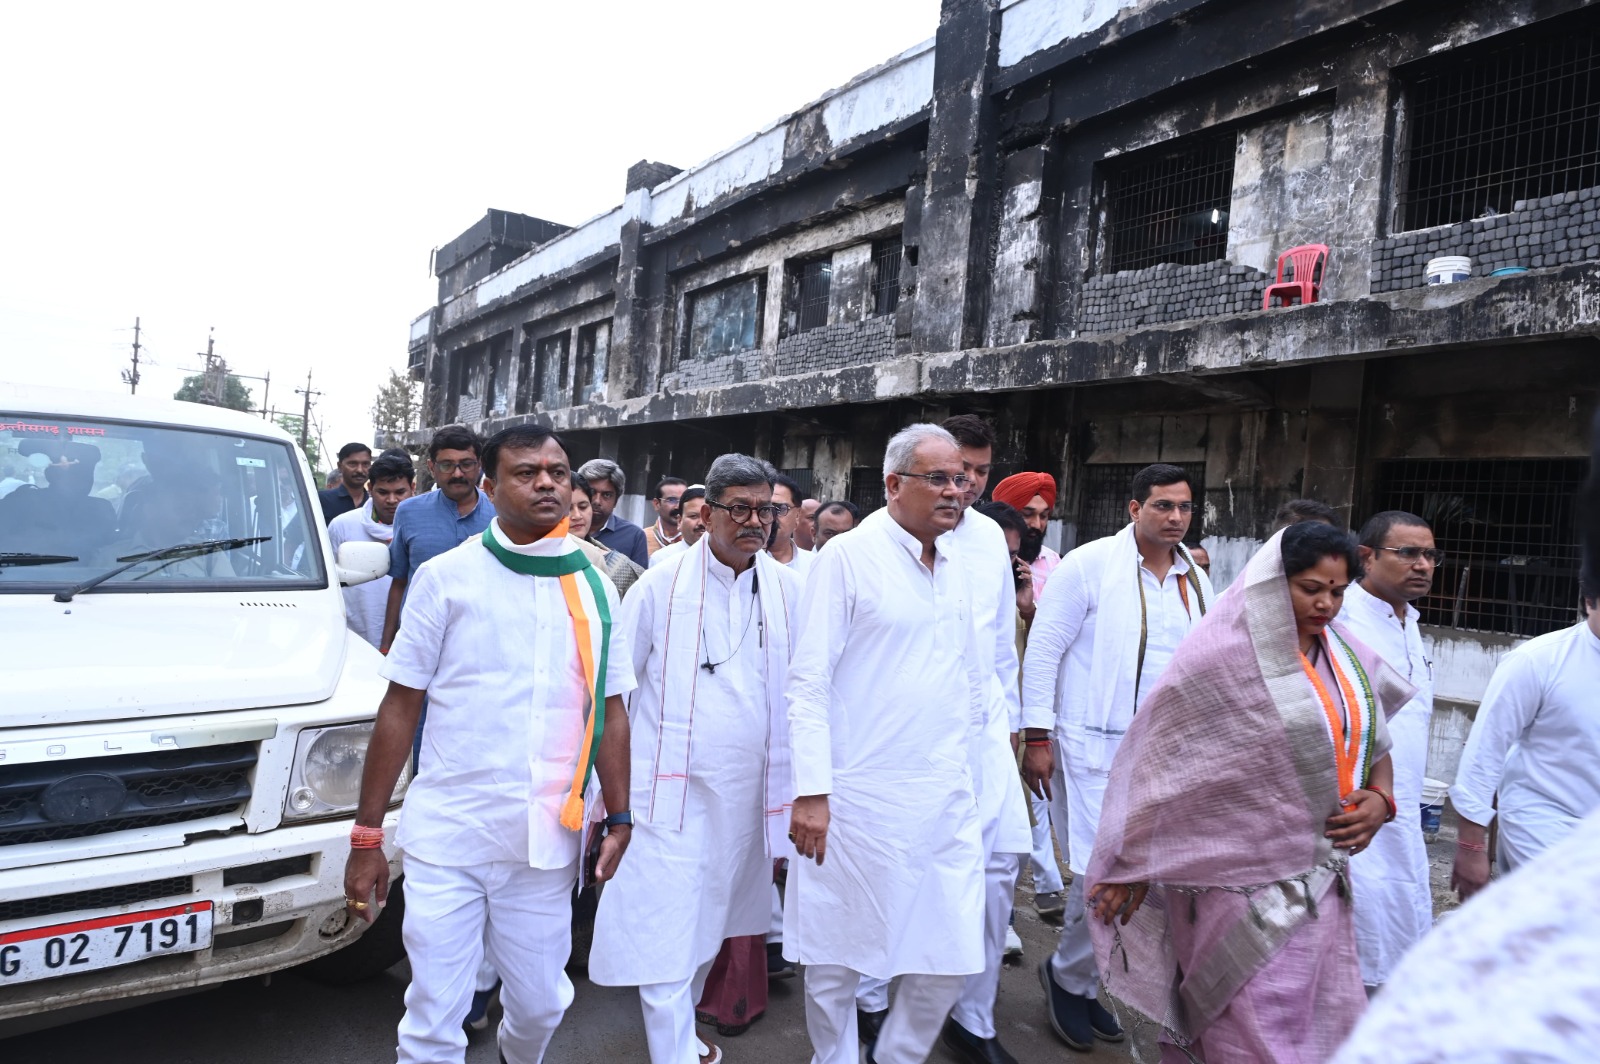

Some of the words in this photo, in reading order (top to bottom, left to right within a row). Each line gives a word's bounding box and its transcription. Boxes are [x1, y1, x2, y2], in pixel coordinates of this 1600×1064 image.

[67, 426, 105, 436] शासन
[45, 933, 90, 968] 02
[114, 914, 198, 957] 7191
